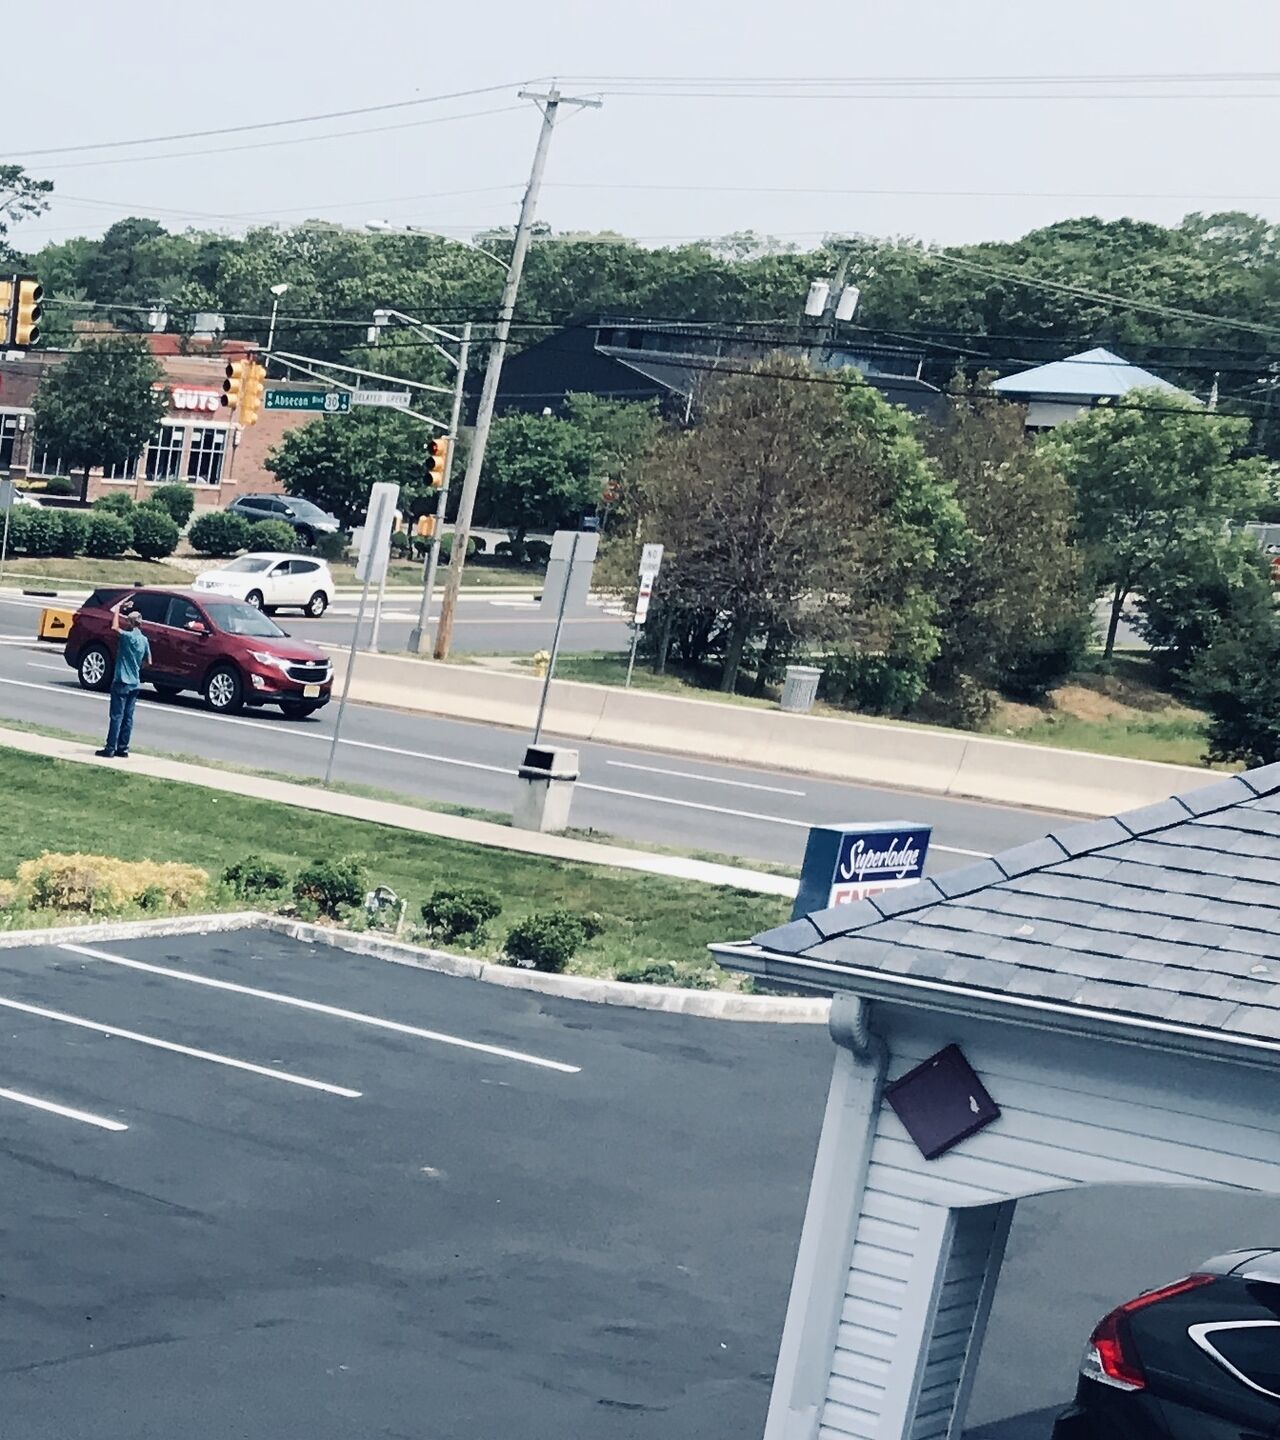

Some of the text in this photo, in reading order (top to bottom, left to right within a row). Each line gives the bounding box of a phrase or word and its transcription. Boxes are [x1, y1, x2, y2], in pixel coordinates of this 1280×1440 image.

[173, 388, 219, 411] GUYS
[275, 395, 309, 406] Absecon
[326, 396, 338, 407] 30
[840, 836, 920, 881] Superlodge
